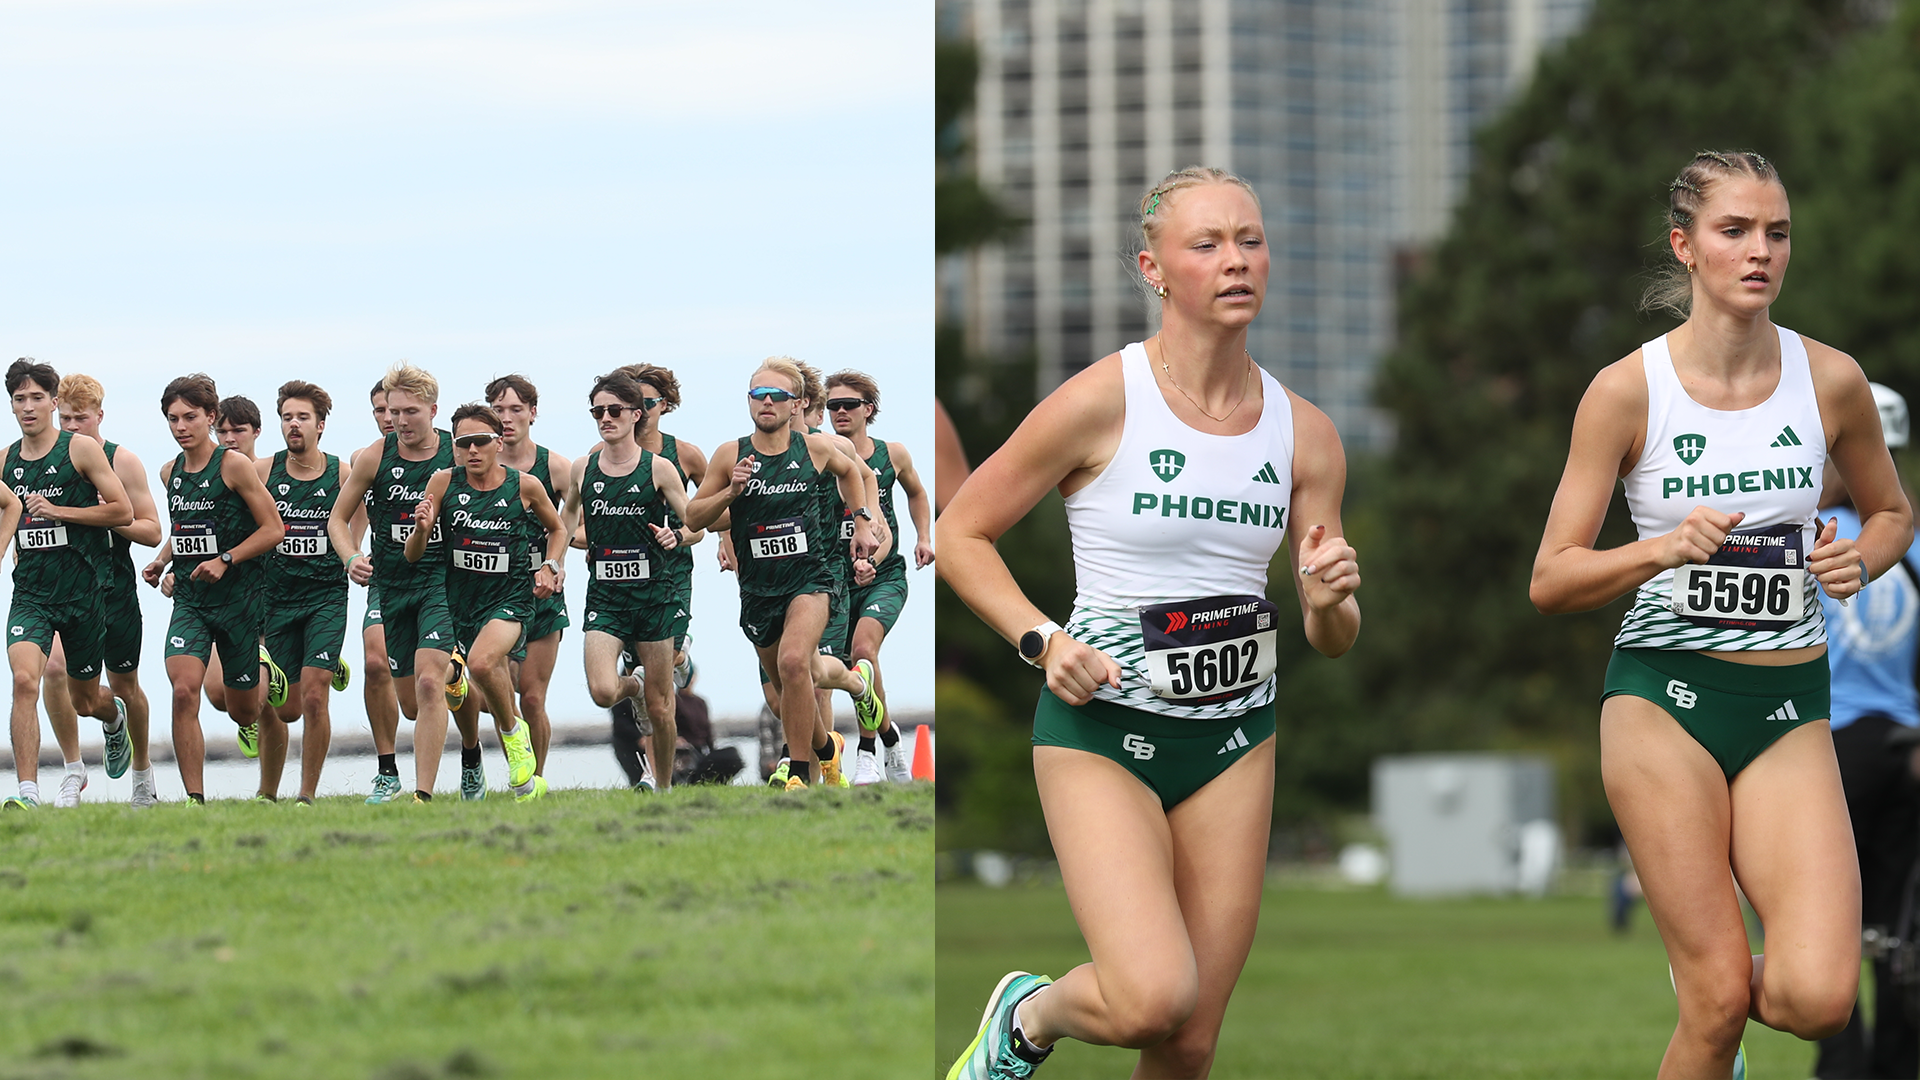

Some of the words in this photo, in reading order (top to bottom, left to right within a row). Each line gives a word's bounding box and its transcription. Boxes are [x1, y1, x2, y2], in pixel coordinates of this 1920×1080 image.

[745, 479, 807, 496] Phoenix
[1663, 466, 1814, 499] PHOENIX
[387, 484, 426, 500] Phoe
[171, 495, 215, 511] Phoenix
[275, 500, 330, 518] Phoenix
[591, 499, 645, 515] Phoenix
[1132, 492, 1286, 529] PHOENIX
[451, 510, 511, 530] Phoenix
[27, 530, 56, 547] 5611
[176, 537, 208, 553] 5841
[283, 538, 317, 553] 5613
[760, 536, 797, 555] 5618
[1723, 535, 1786, 546] PRIMETIME
[1722, 545, 1758, 553] TIMING
[464, 553, 498, 570] 5617
[605, 562, 640, 578] 5913
[1687, 570, 1790, 615] 5596
[1191, 601, 1259, 623] PRIMETIME
[1191, 619, 1229, 631] TIMING
[1167, 639, 1258, 695] 5602
[1666, 680, 1698, 709] GB
[1123, 733, 1156, 760] GB
